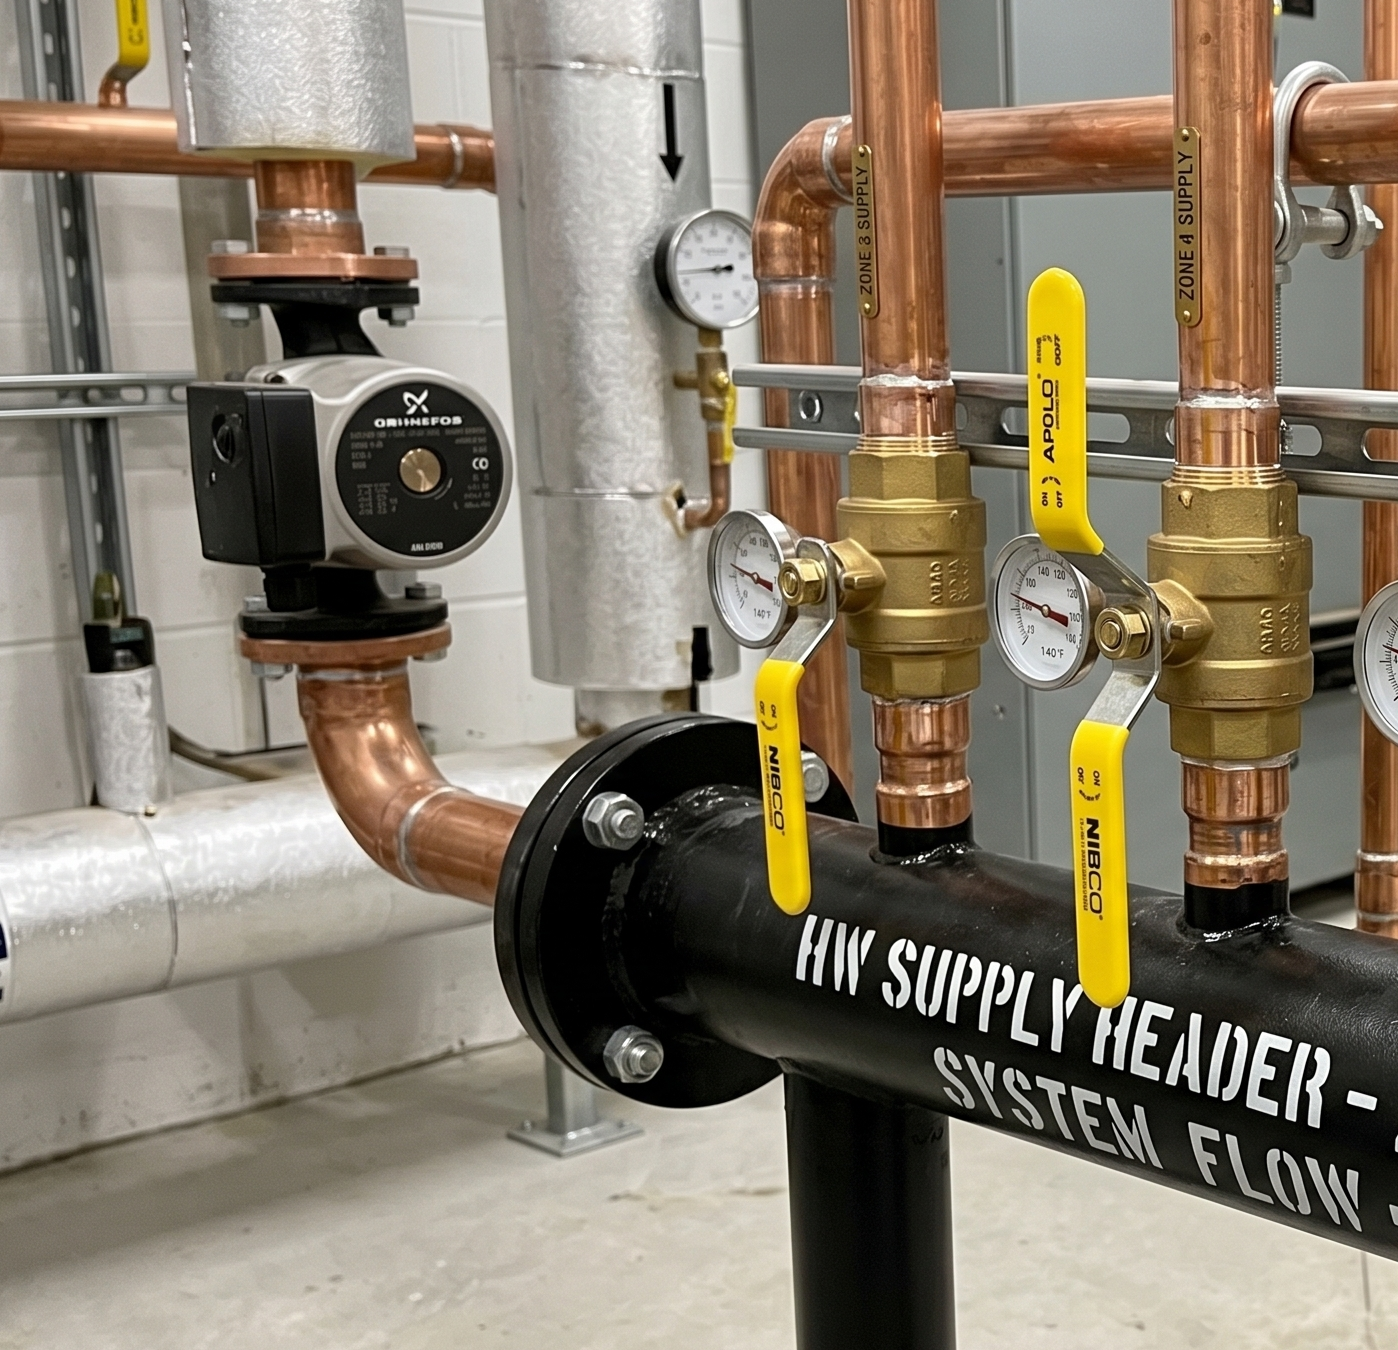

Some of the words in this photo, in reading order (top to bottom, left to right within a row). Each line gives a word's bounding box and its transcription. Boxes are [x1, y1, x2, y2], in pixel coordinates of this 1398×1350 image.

[855, 165, 870, 230] SUPPLY
[1177, 151, 1194, 225] SUPPLY
[858, 251, 872, 296] ZONE
[1179, 250, 1194, 301] ZONE
[1042, 378, 1056, 464] APOLO
[768, 744, 785, 831] NIBCO
[1092, 770, 1101, 787] ON
[1086, 817, 1103, 915] NIBCO
[795, 913, 877, 996] HW
[882, 938, 1084, 1053] SUPPLY
[1092, 995, 1331, 1129] HEADER
[933, 1047, 1164, 1170] SYSTEM
[1187, 1121, 1363, 1232] FLOW
